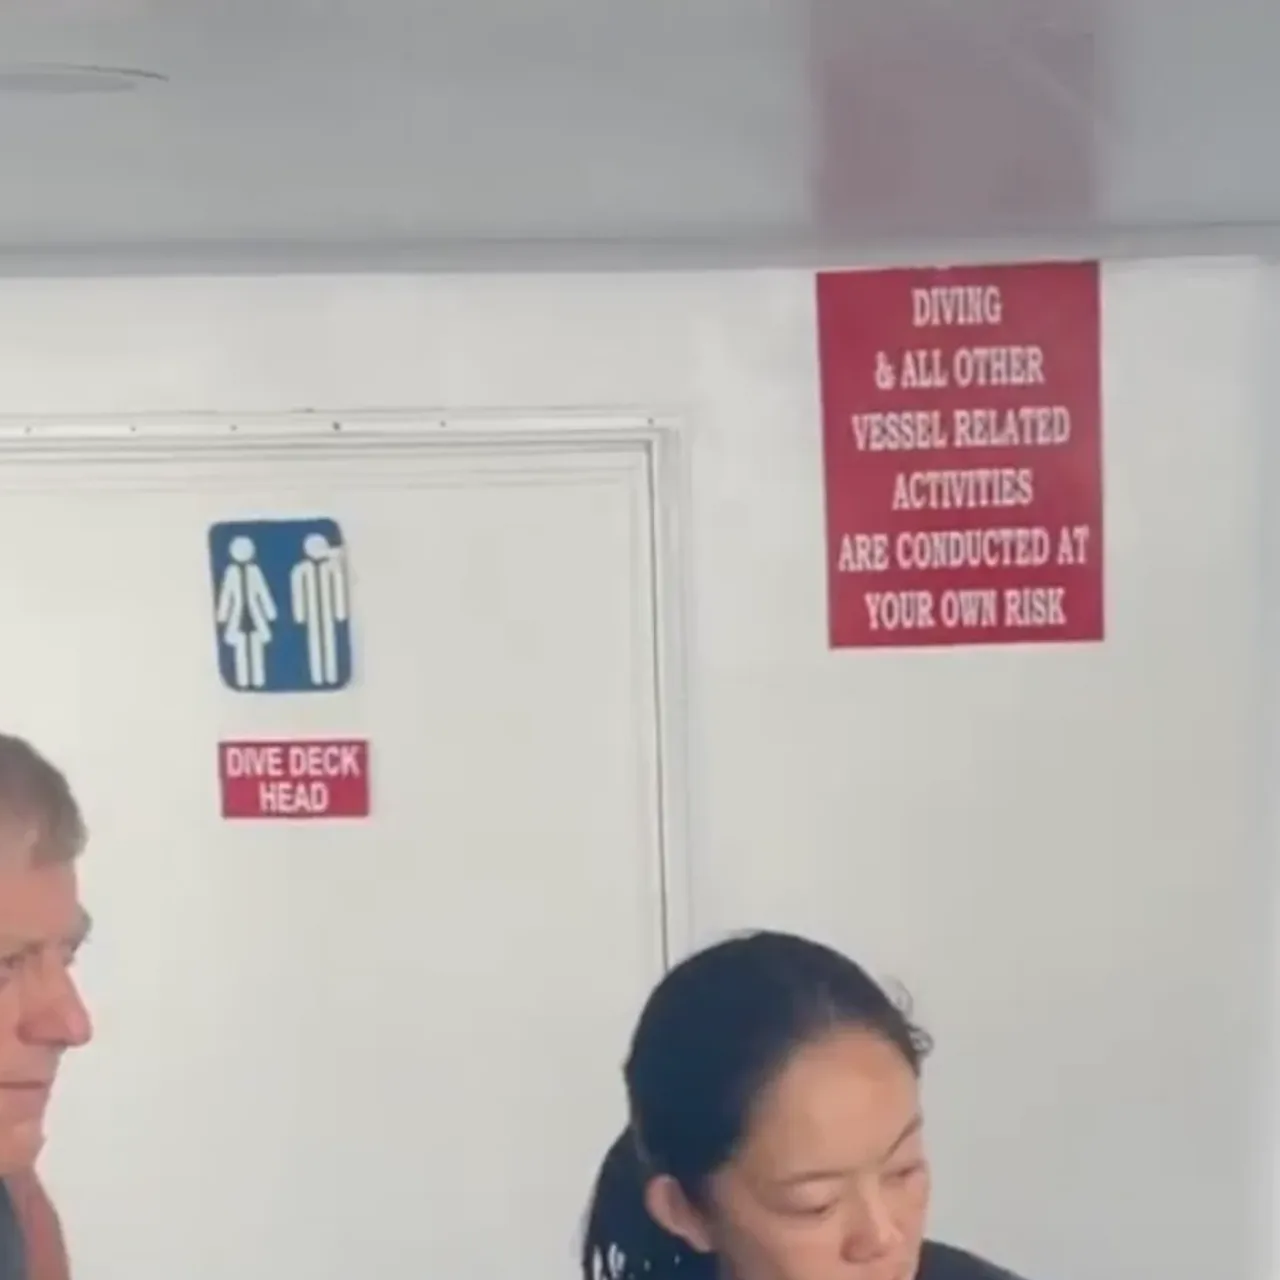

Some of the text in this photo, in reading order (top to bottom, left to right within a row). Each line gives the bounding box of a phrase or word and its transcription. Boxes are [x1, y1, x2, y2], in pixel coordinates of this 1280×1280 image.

[912, 286, 1002, 327] DIVING
[875, 346, 1045, 390] & ALL OTHER
[852, 406, 1070, 451] VESSEL RELATED
[892, 468, 1033, 510] ACTIVITIES
[838, 525, 1089, 571] ARE CONDUCTED AT
[864, 587, 1066, 630] YOUR OWN RISK
[226, 745, 360, 778] DIVE DECK
[258, 781, 329, 813] HEAD
